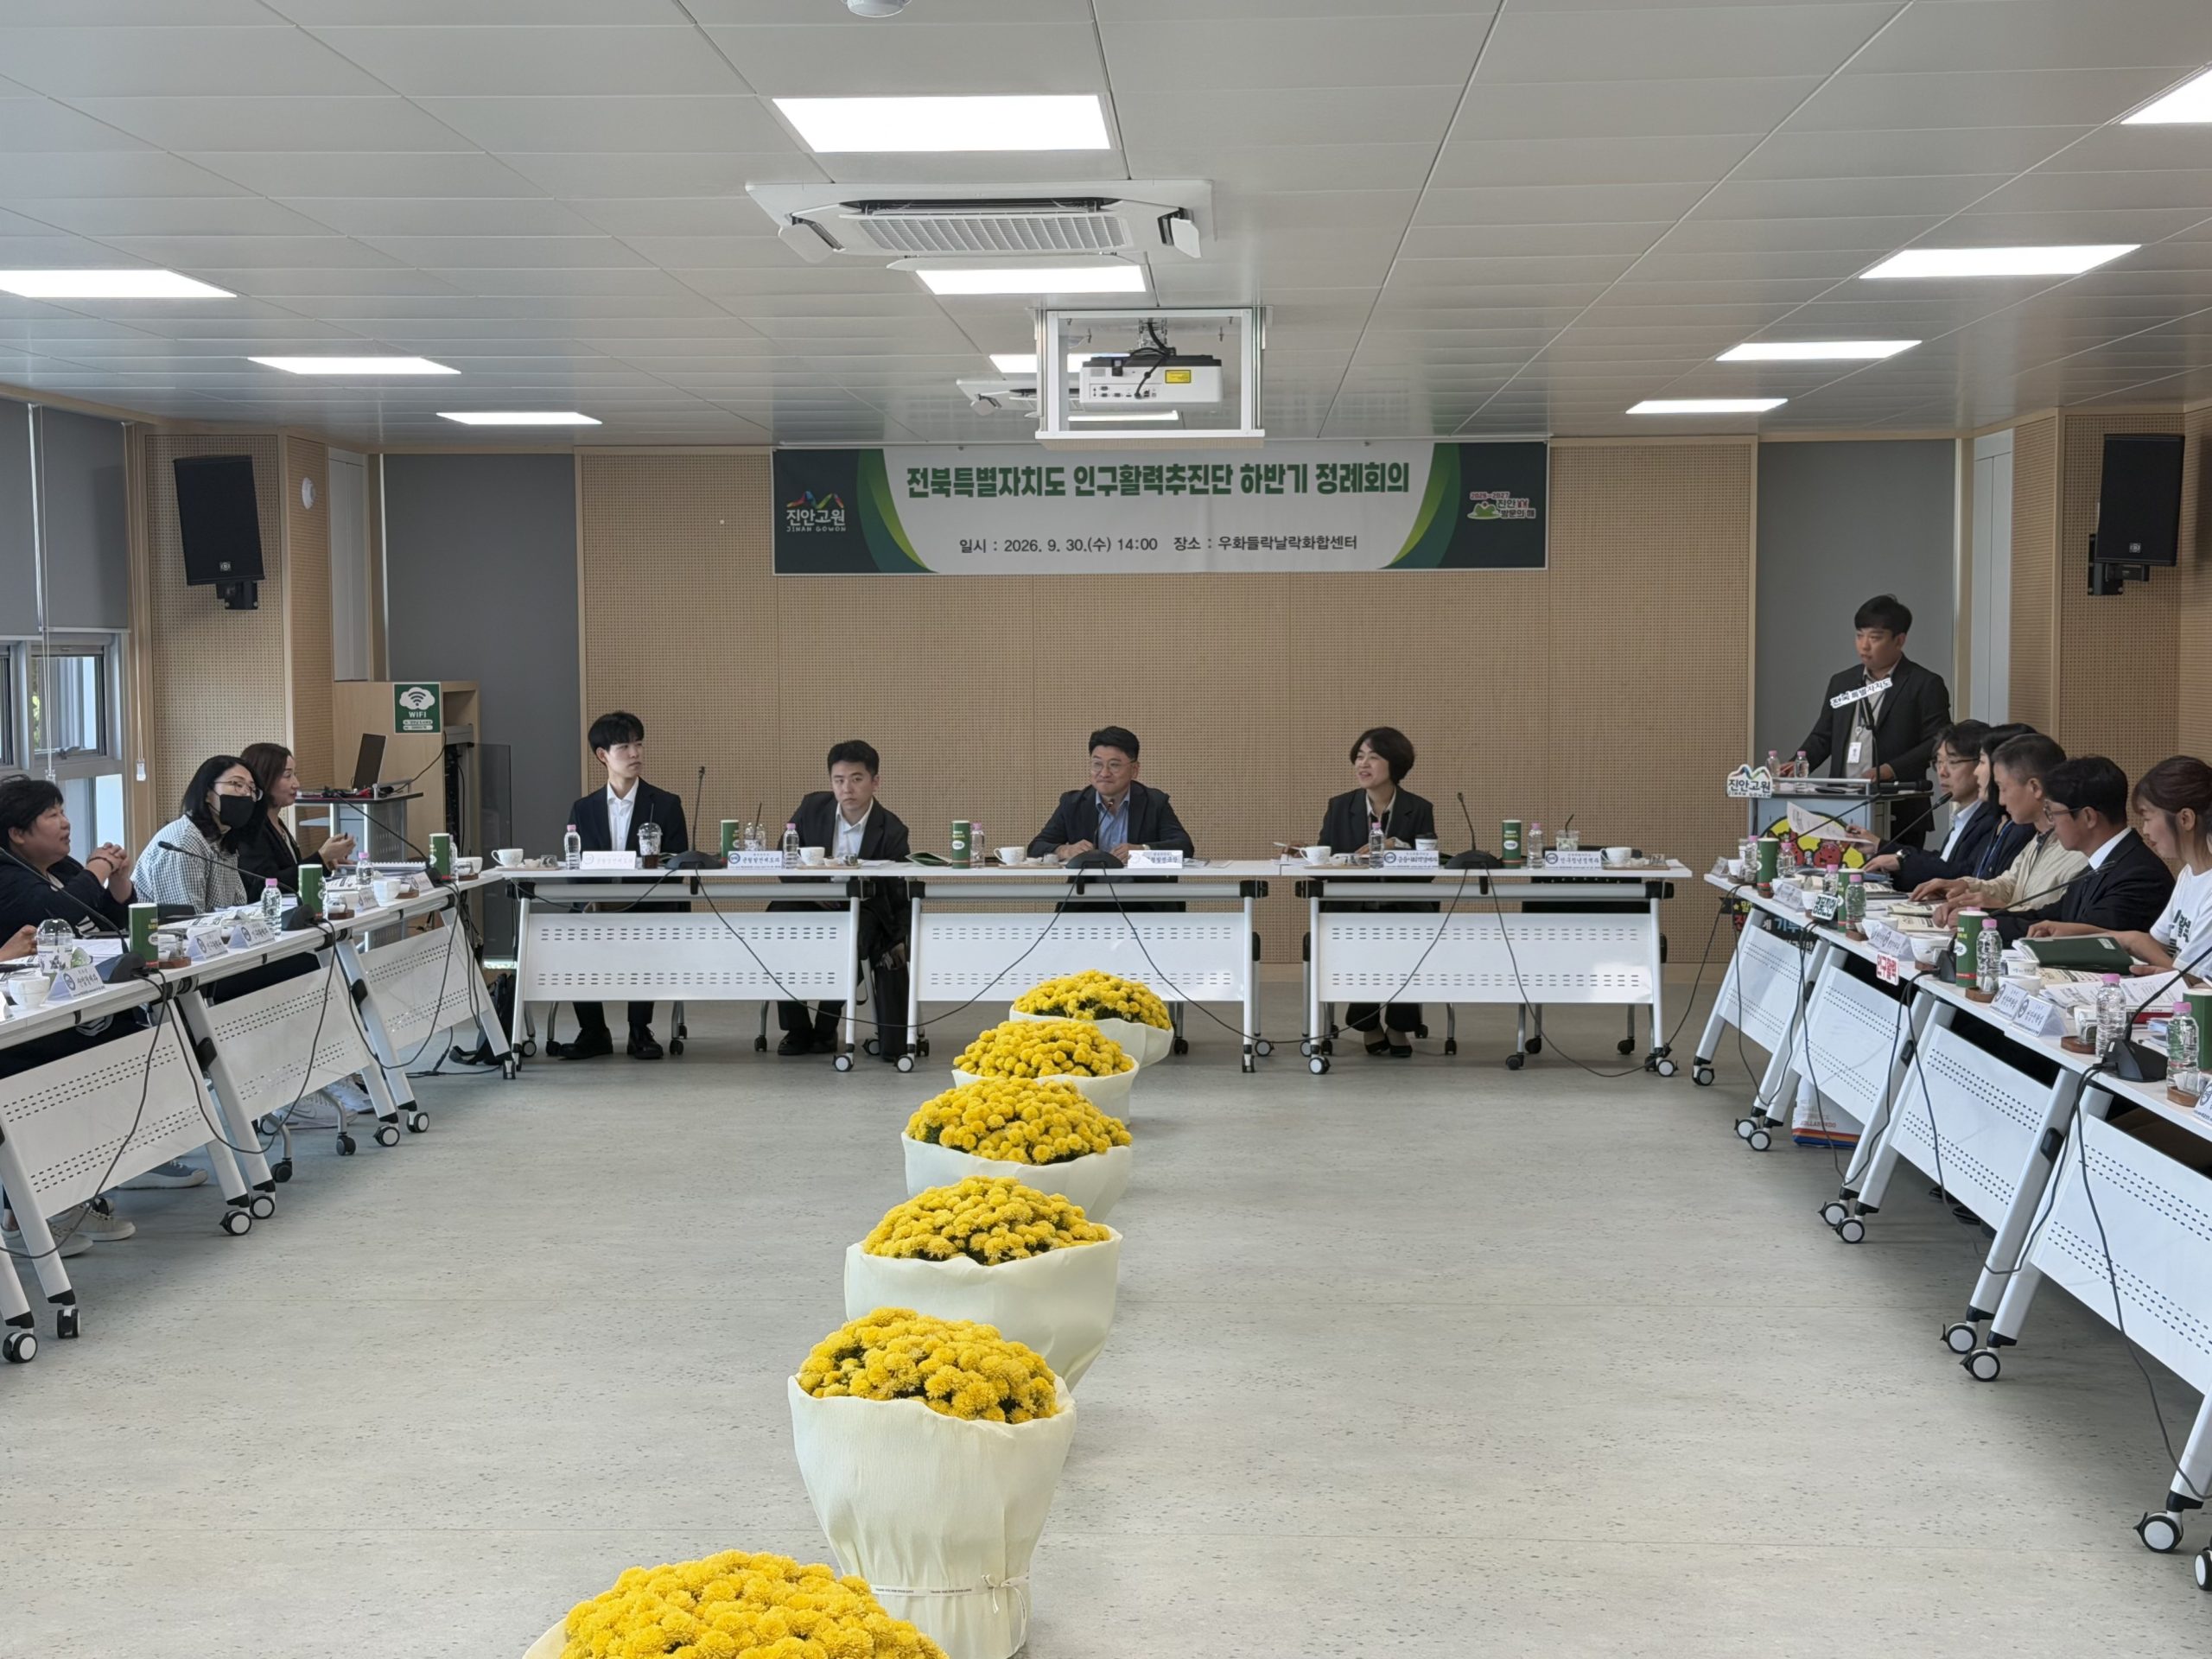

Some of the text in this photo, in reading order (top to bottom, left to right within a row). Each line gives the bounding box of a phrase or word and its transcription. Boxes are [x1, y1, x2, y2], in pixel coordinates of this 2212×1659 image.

[906, 461, 1409, 498] 전북특별자치도 인구활력추진단 하반기 정례회의
[786, 509, 845, 526] 진안고원
[959, 538, 987, 554] 일시
[1004, 539, 1042, 553] 2026.
[1047, 540, 1061, 553] 9.
[1066, 537, 1111, 553] 30.(수)
[1117, 538, 1158, 551] 14:00
[1173, 536, 1201, 551] 장소
[1217, 535, 1357, 551] 우화들락날락화합센터
[1832, 679, 1891, 706] 전북특별자치도
[1728, 779, 1770, 793] 진안고원
